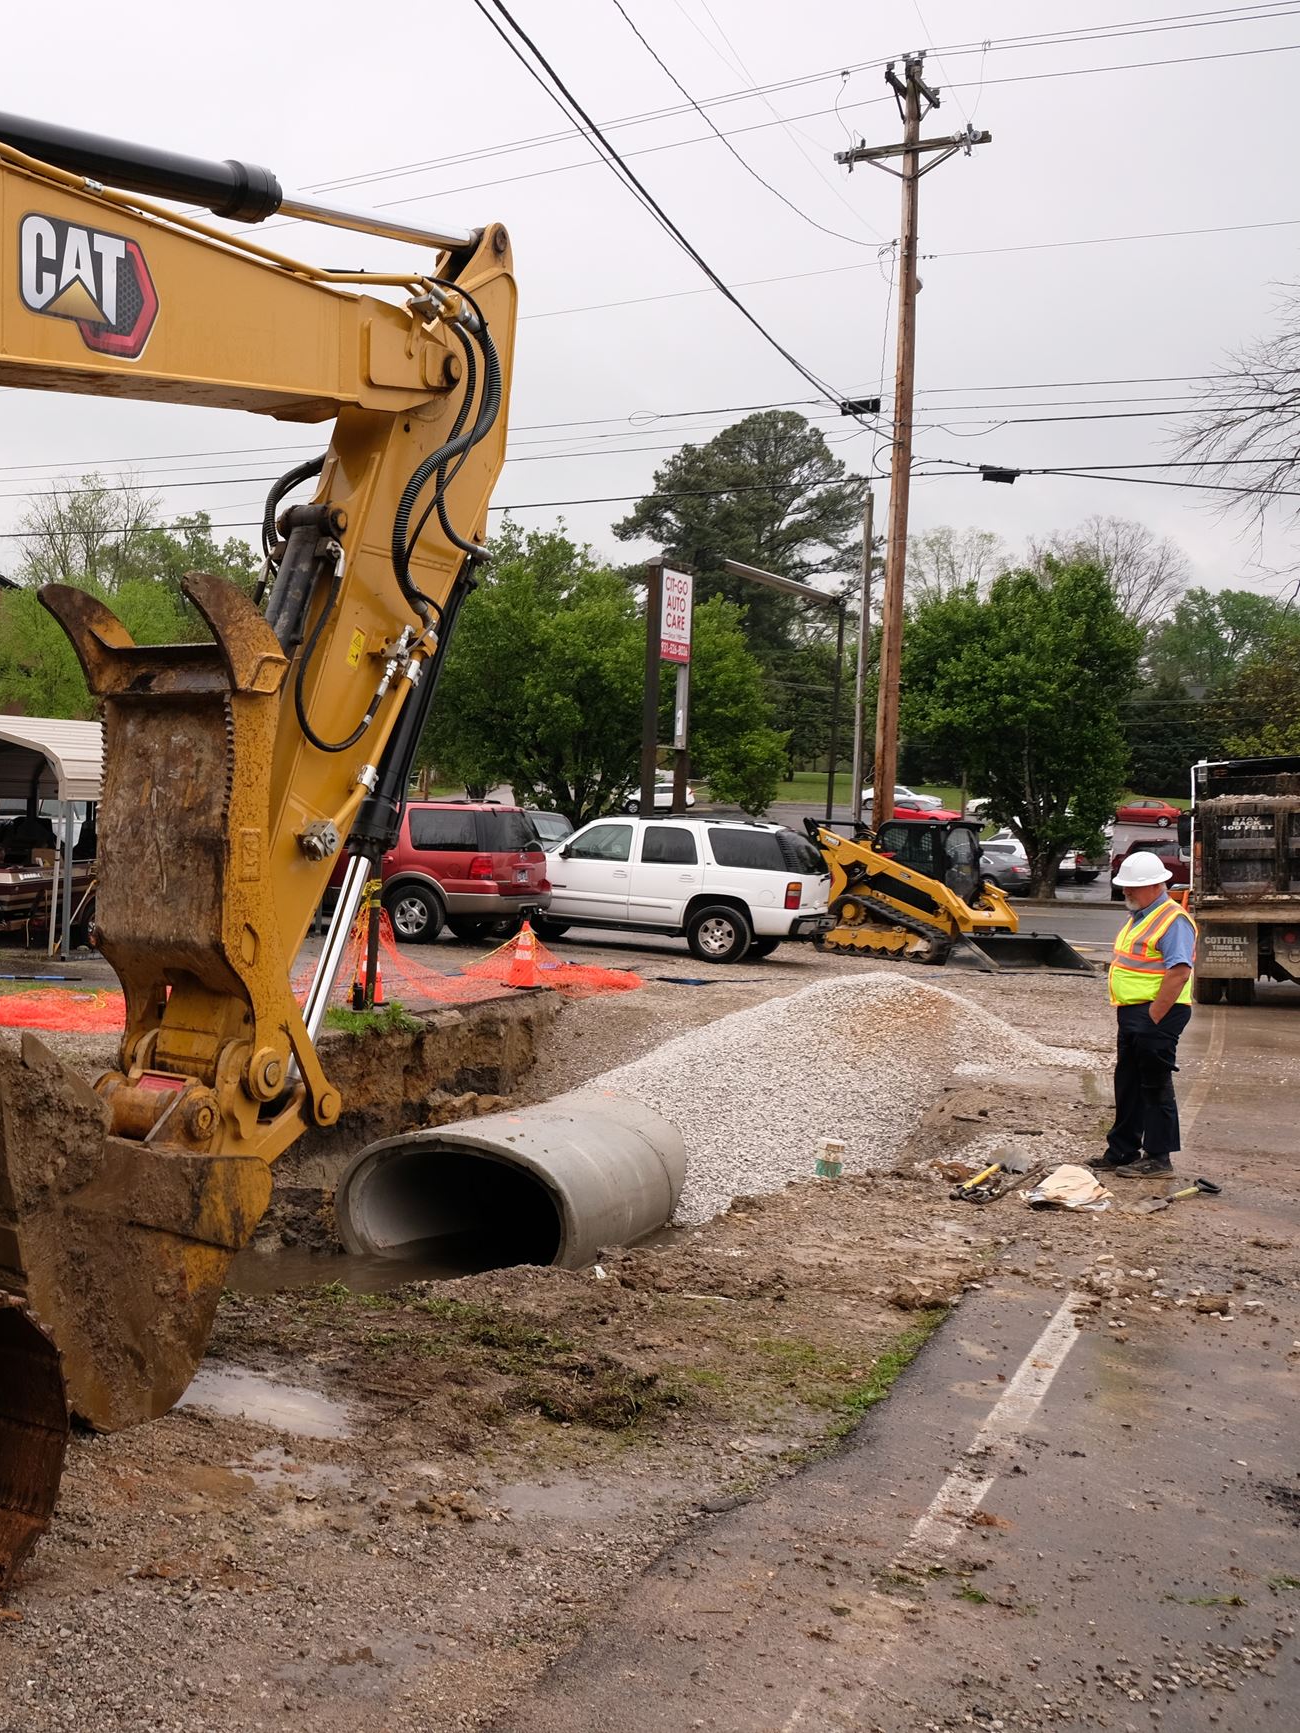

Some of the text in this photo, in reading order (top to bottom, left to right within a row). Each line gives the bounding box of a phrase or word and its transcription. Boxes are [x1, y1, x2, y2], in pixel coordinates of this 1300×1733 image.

[21, 216, 126, 326] CAT
[665, 576, 689, 596] CIT-GO
[666, 594, 686, 613] AUTO
[665, 613, 685, 631] CARE
[1204, 936, 1250, 945] COTTRELL
